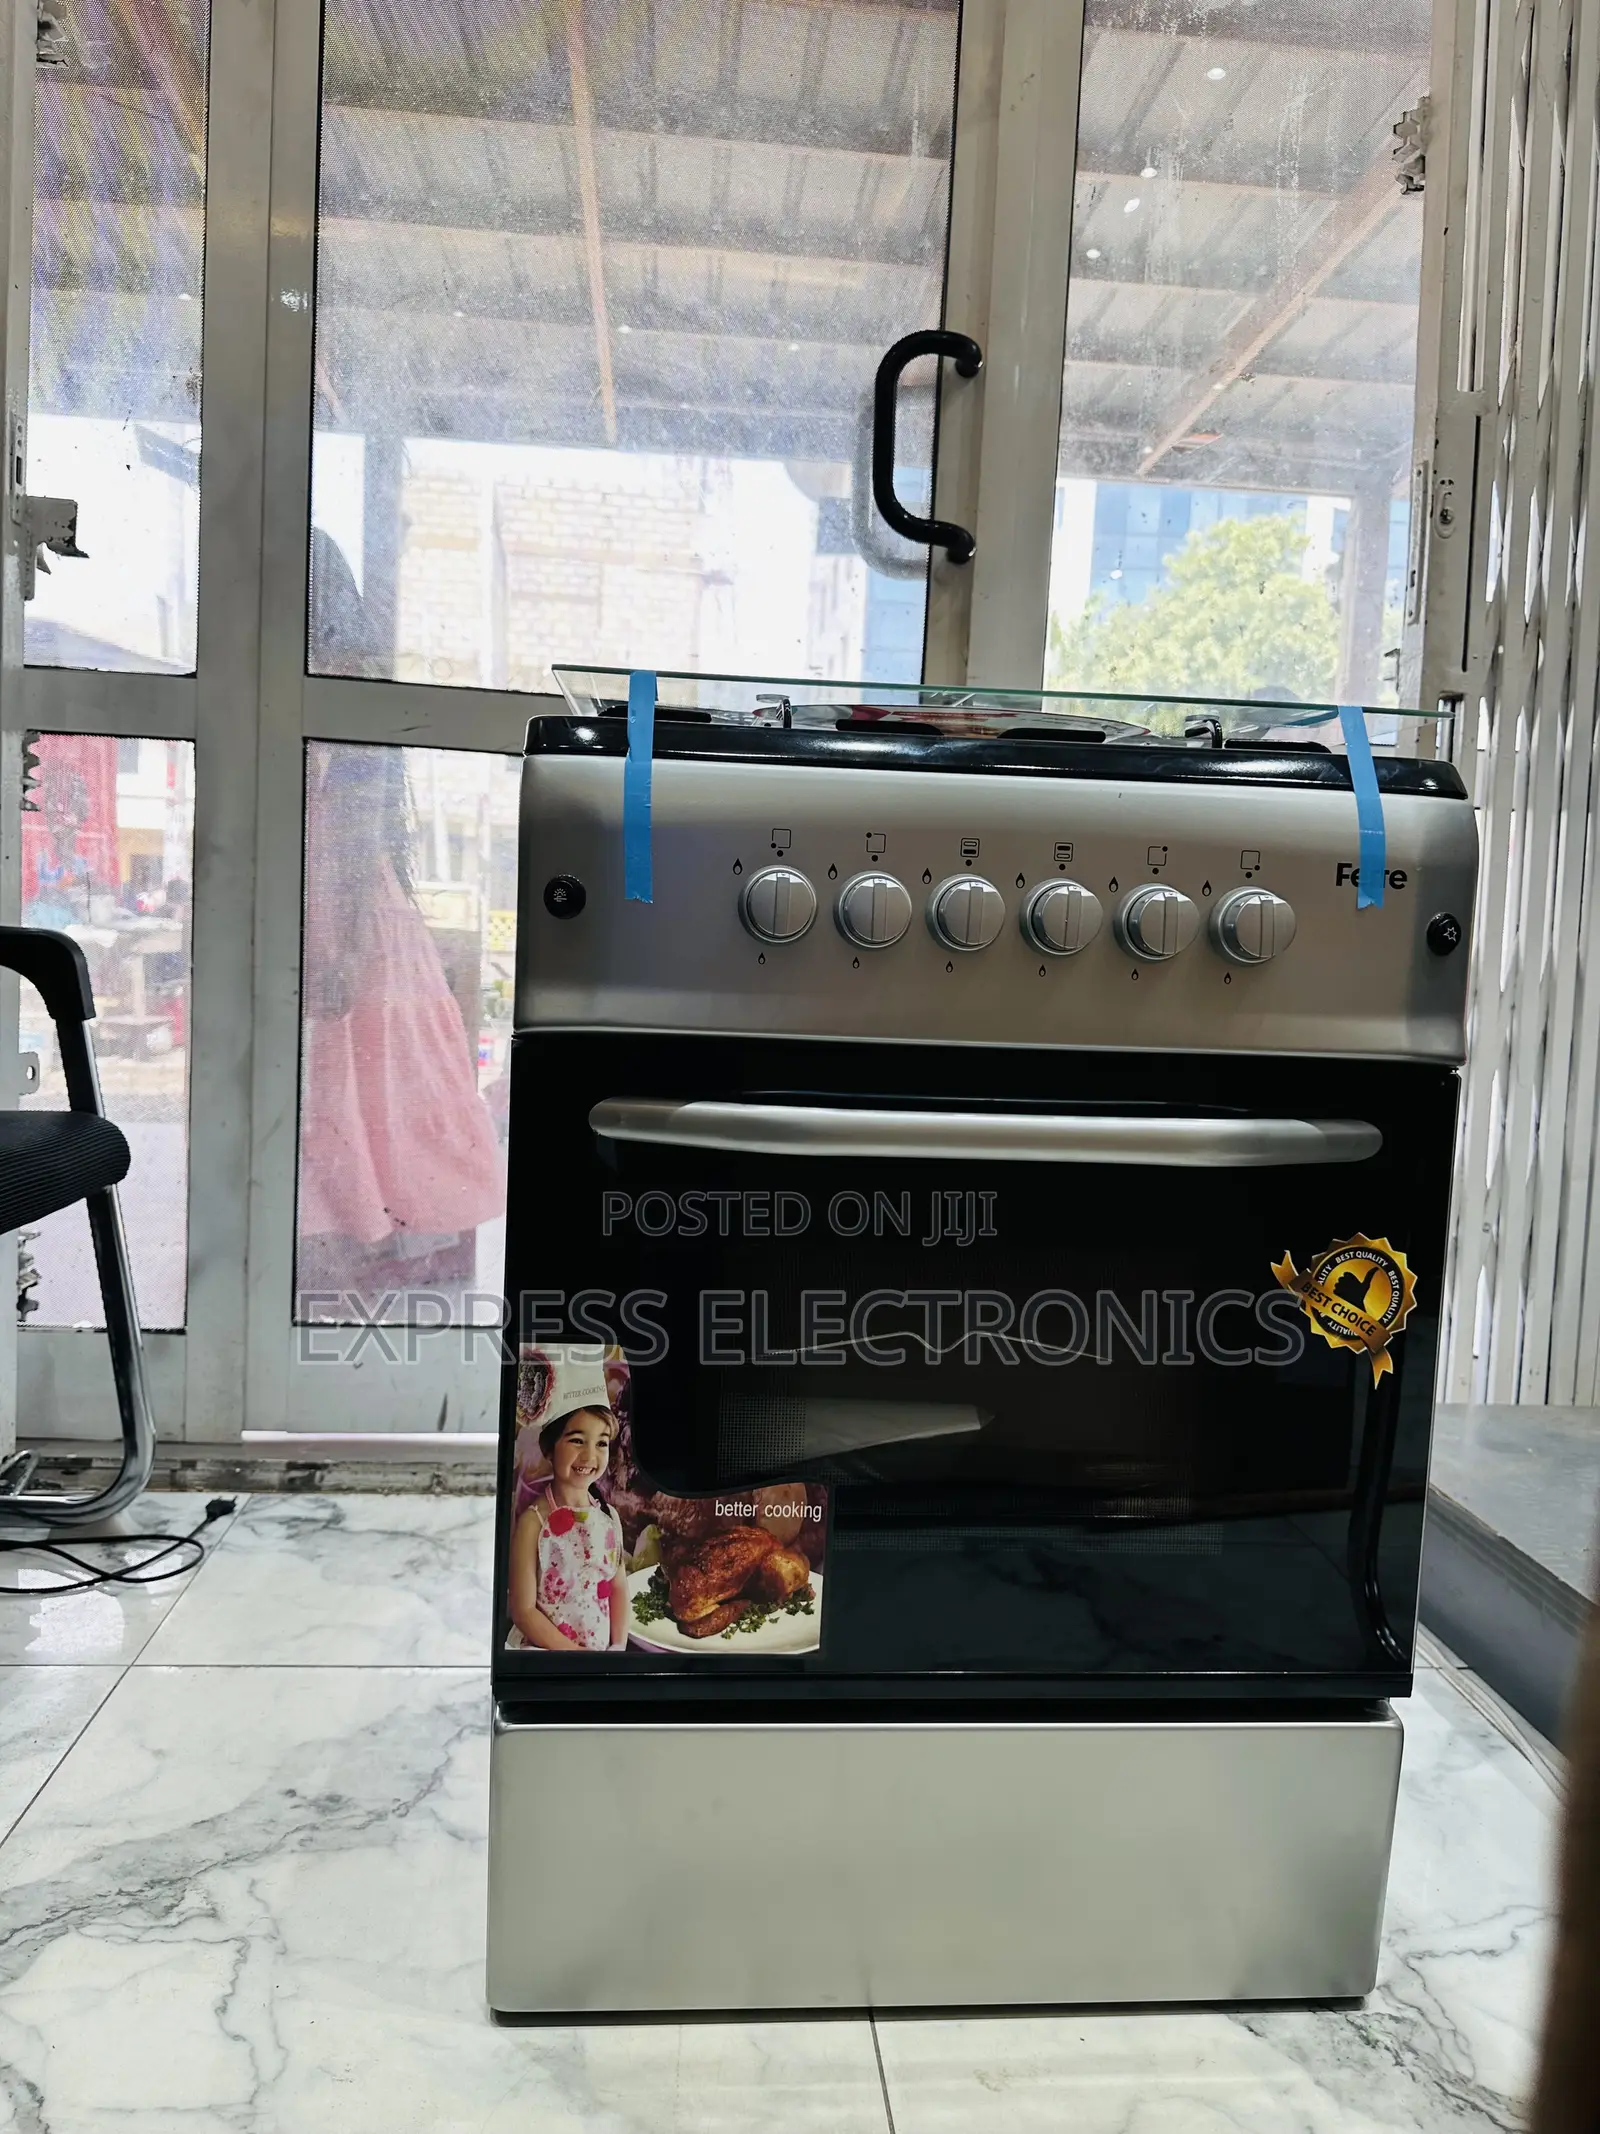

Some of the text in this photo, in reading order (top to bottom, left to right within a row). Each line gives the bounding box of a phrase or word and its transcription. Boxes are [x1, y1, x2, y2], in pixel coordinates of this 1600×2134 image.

[1335, 862, 1408, 890] Fere
[1335, 1250, 1389, 1268] BEST QUALITY
[1317, 1263, 1333, 1286] ALITY
[1301, 1282, 1377, 1337] BEST CHOICE
[1381, 1270, 1401, 1324] BEST QUALITY
[715, 1499, 822, 1523] better cooking
